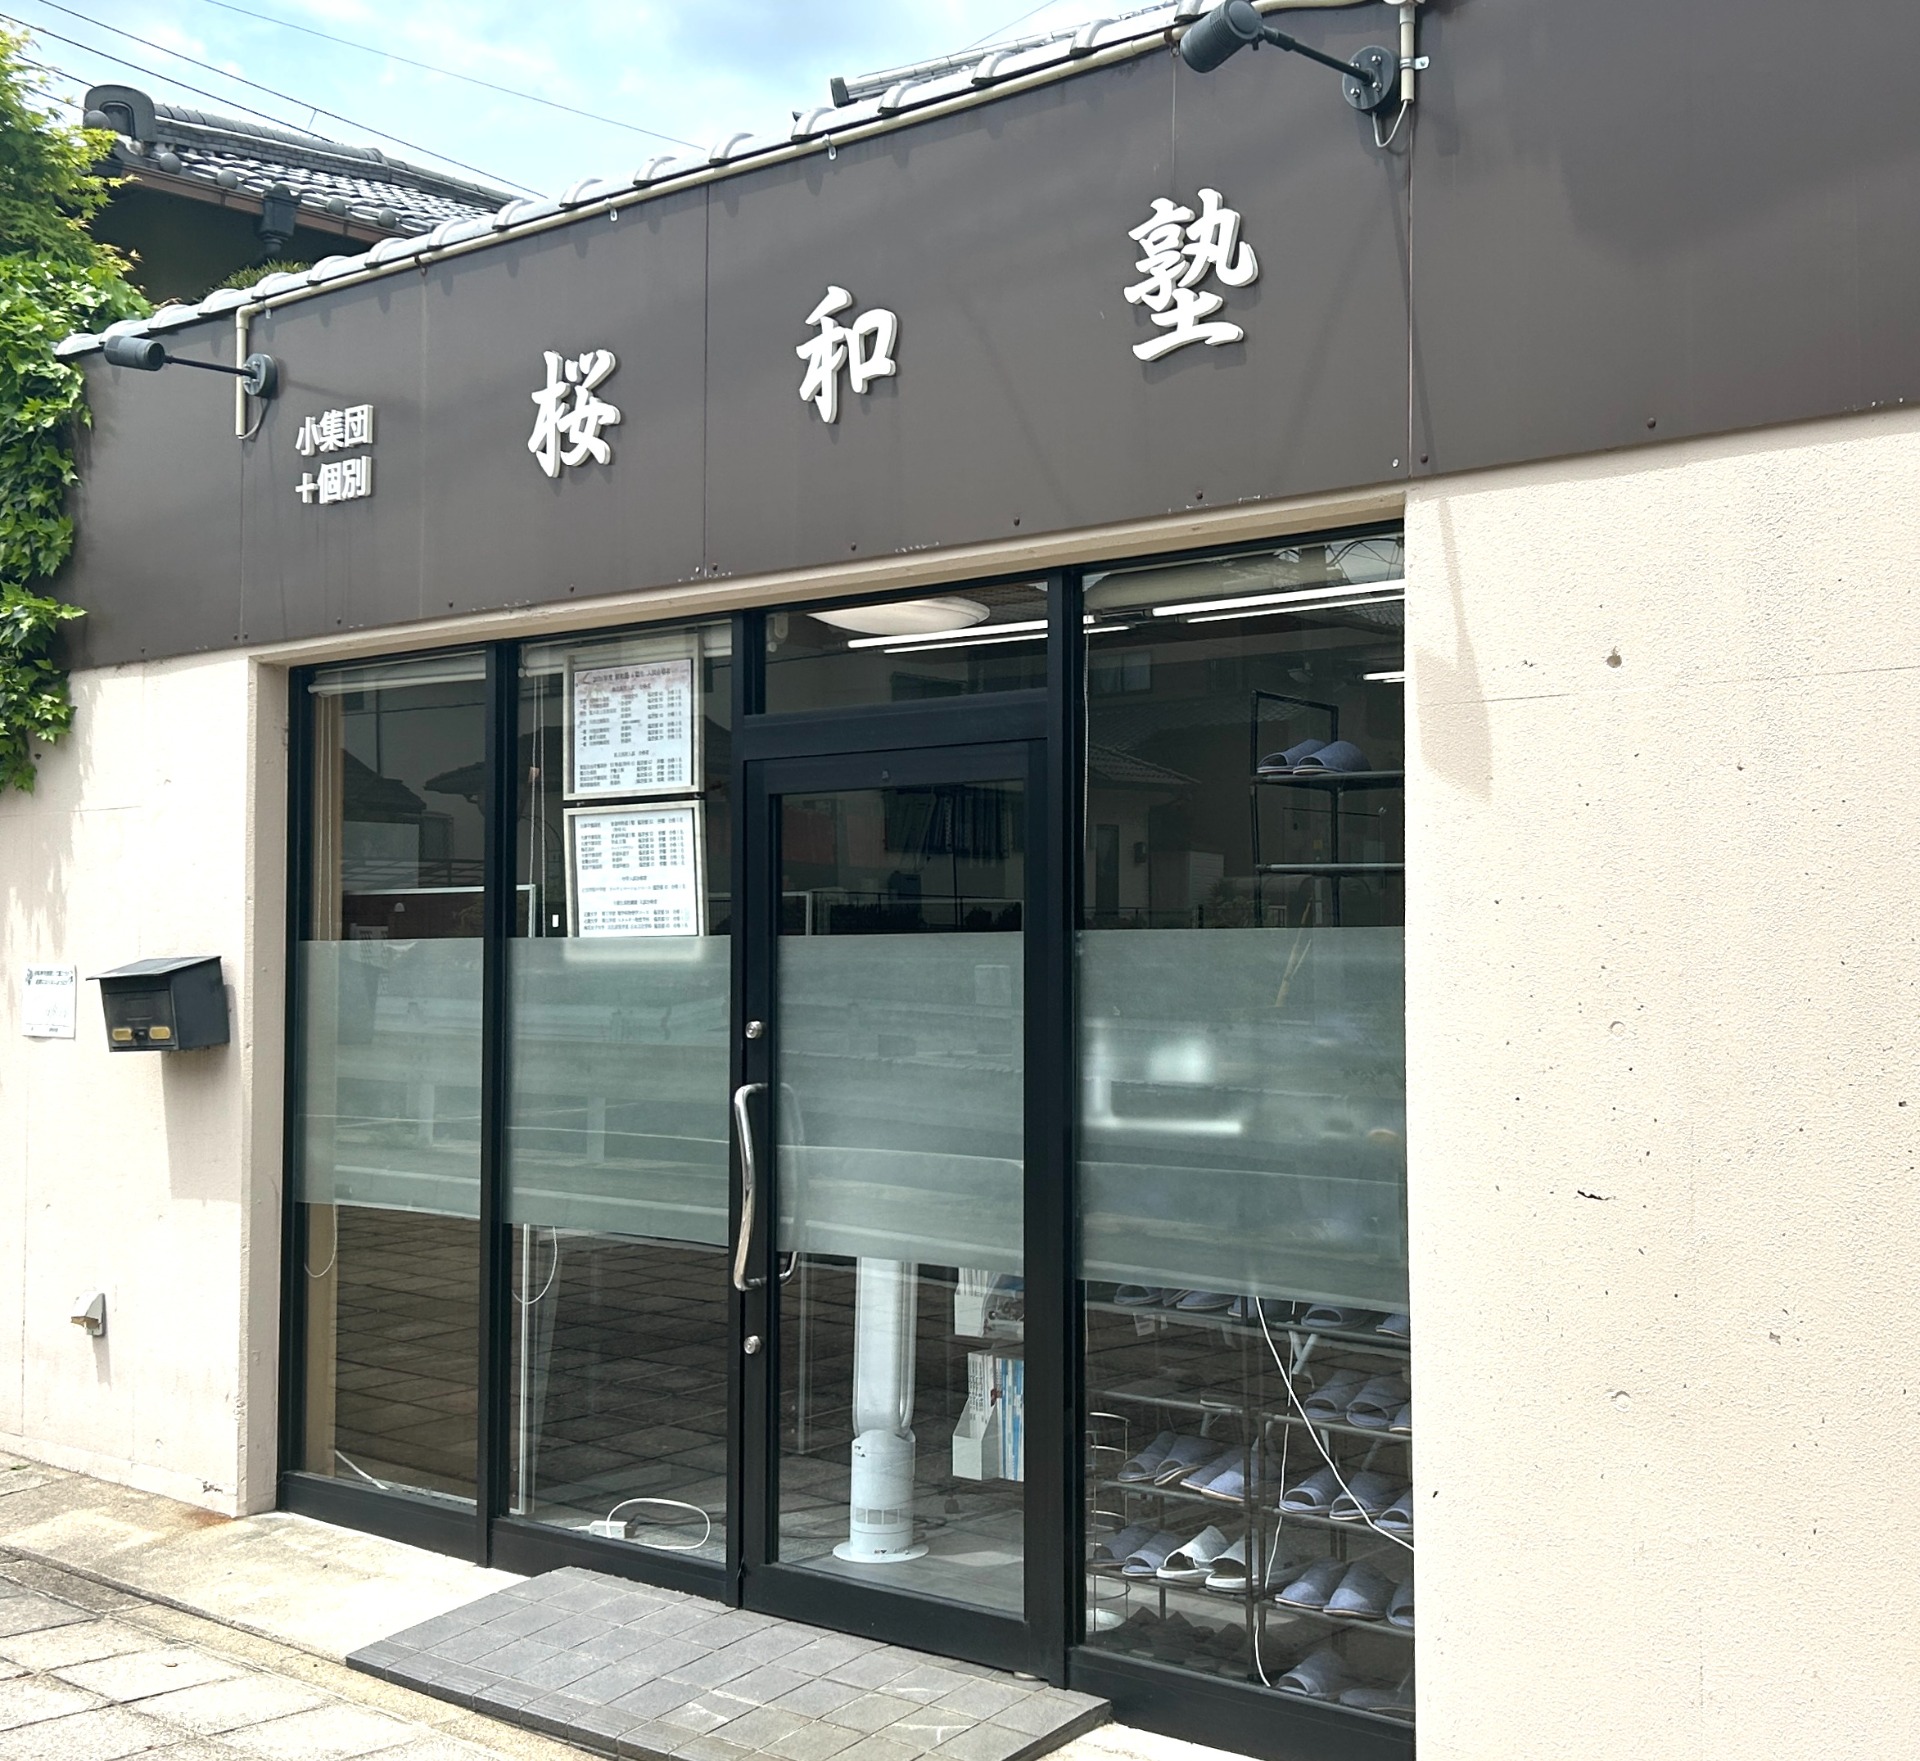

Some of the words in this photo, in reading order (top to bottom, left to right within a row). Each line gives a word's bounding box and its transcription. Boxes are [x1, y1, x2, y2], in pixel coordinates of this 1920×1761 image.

[527, 188, 1259, 478] 桜和塾
[295, 404, 374, 456] 小集団
